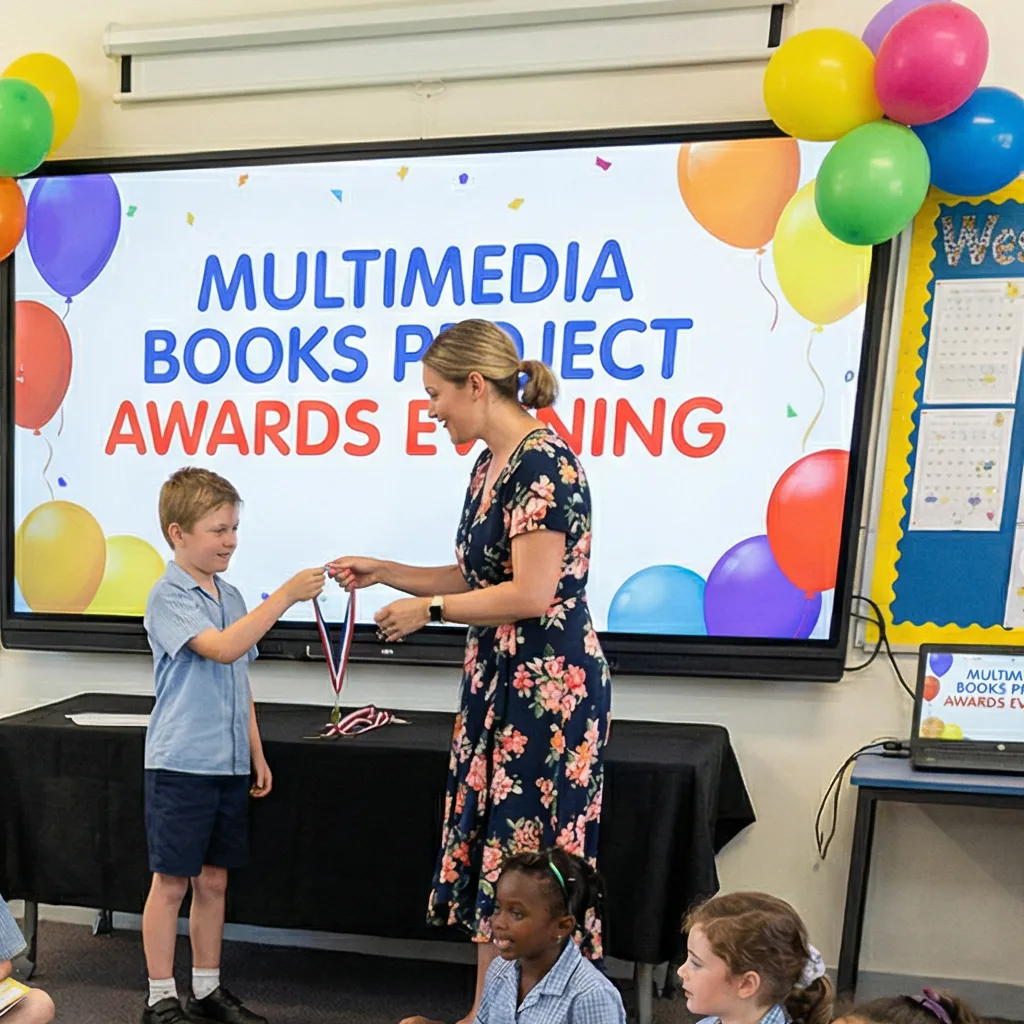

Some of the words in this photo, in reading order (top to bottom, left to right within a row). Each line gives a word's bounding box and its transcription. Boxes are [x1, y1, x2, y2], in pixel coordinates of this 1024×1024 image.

[197, 239, 634, 313] MULTIMEDIA
[143, 325, 369, 385] BOOKS
[393, 317, 694, 383] PJECT
[105, 399, 381, 457] AWARDS
[406, 396, 726, 459] ENING
[944, 696, 1005, 708] AWARDS
[957, 682, 1007, 694] BOOKS
